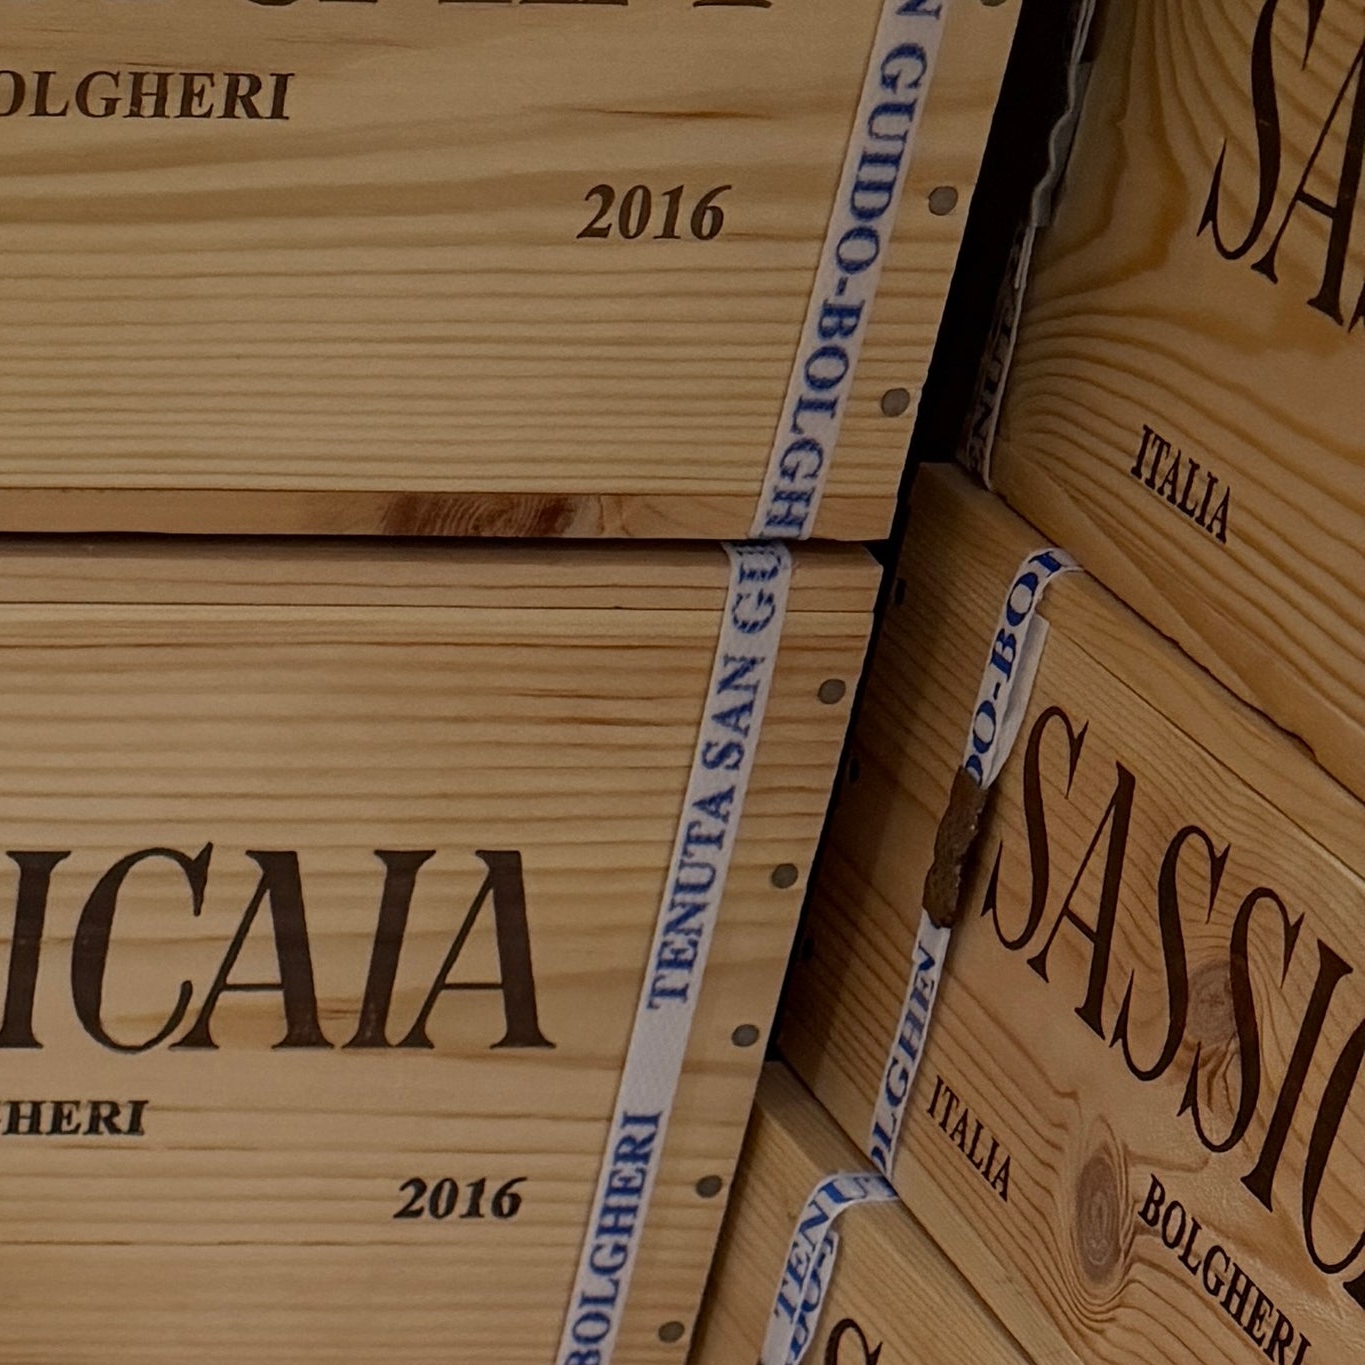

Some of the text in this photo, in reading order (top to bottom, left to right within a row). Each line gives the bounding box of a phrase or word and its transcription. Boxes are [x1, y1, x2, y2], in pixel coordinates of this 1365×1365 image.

[576, 184, 732, 241] 2016
[765, 43, 929, 540] GUIDO-BOLGH
[1130, 423, 1231, 544] ITALIA
[647, 783, 736, 1011] TENUTA
[702, 655, 765, 771] SAN
[392, 1177, 527, 1220] 2016
[926, 1076, 1012, 1202] ITALIA
